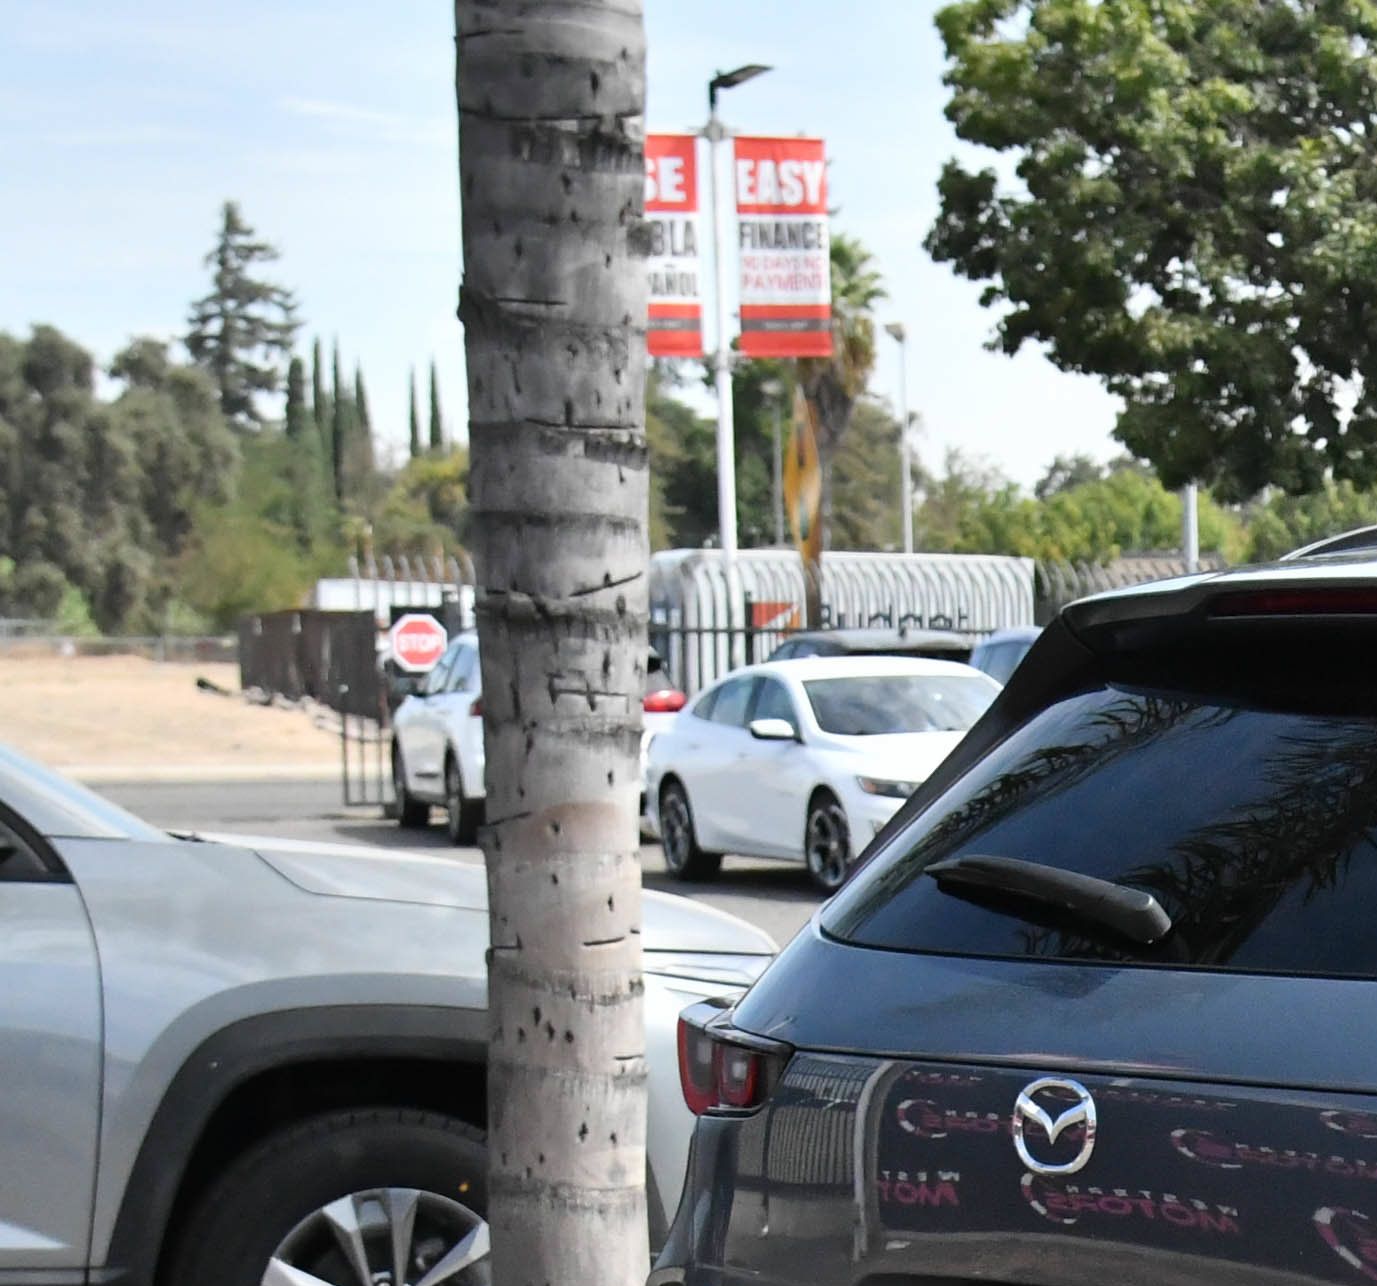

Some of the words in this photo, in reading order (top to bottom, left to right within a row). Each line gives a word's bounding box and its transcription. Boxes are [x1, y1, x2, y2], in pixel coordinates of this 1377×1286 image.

[736, 158, 823, 208] EASY
[652, 219, 698, 257] BLA
[740, 220, 823, 250] FINANCE
[398, 633, 442, 652] STOP
